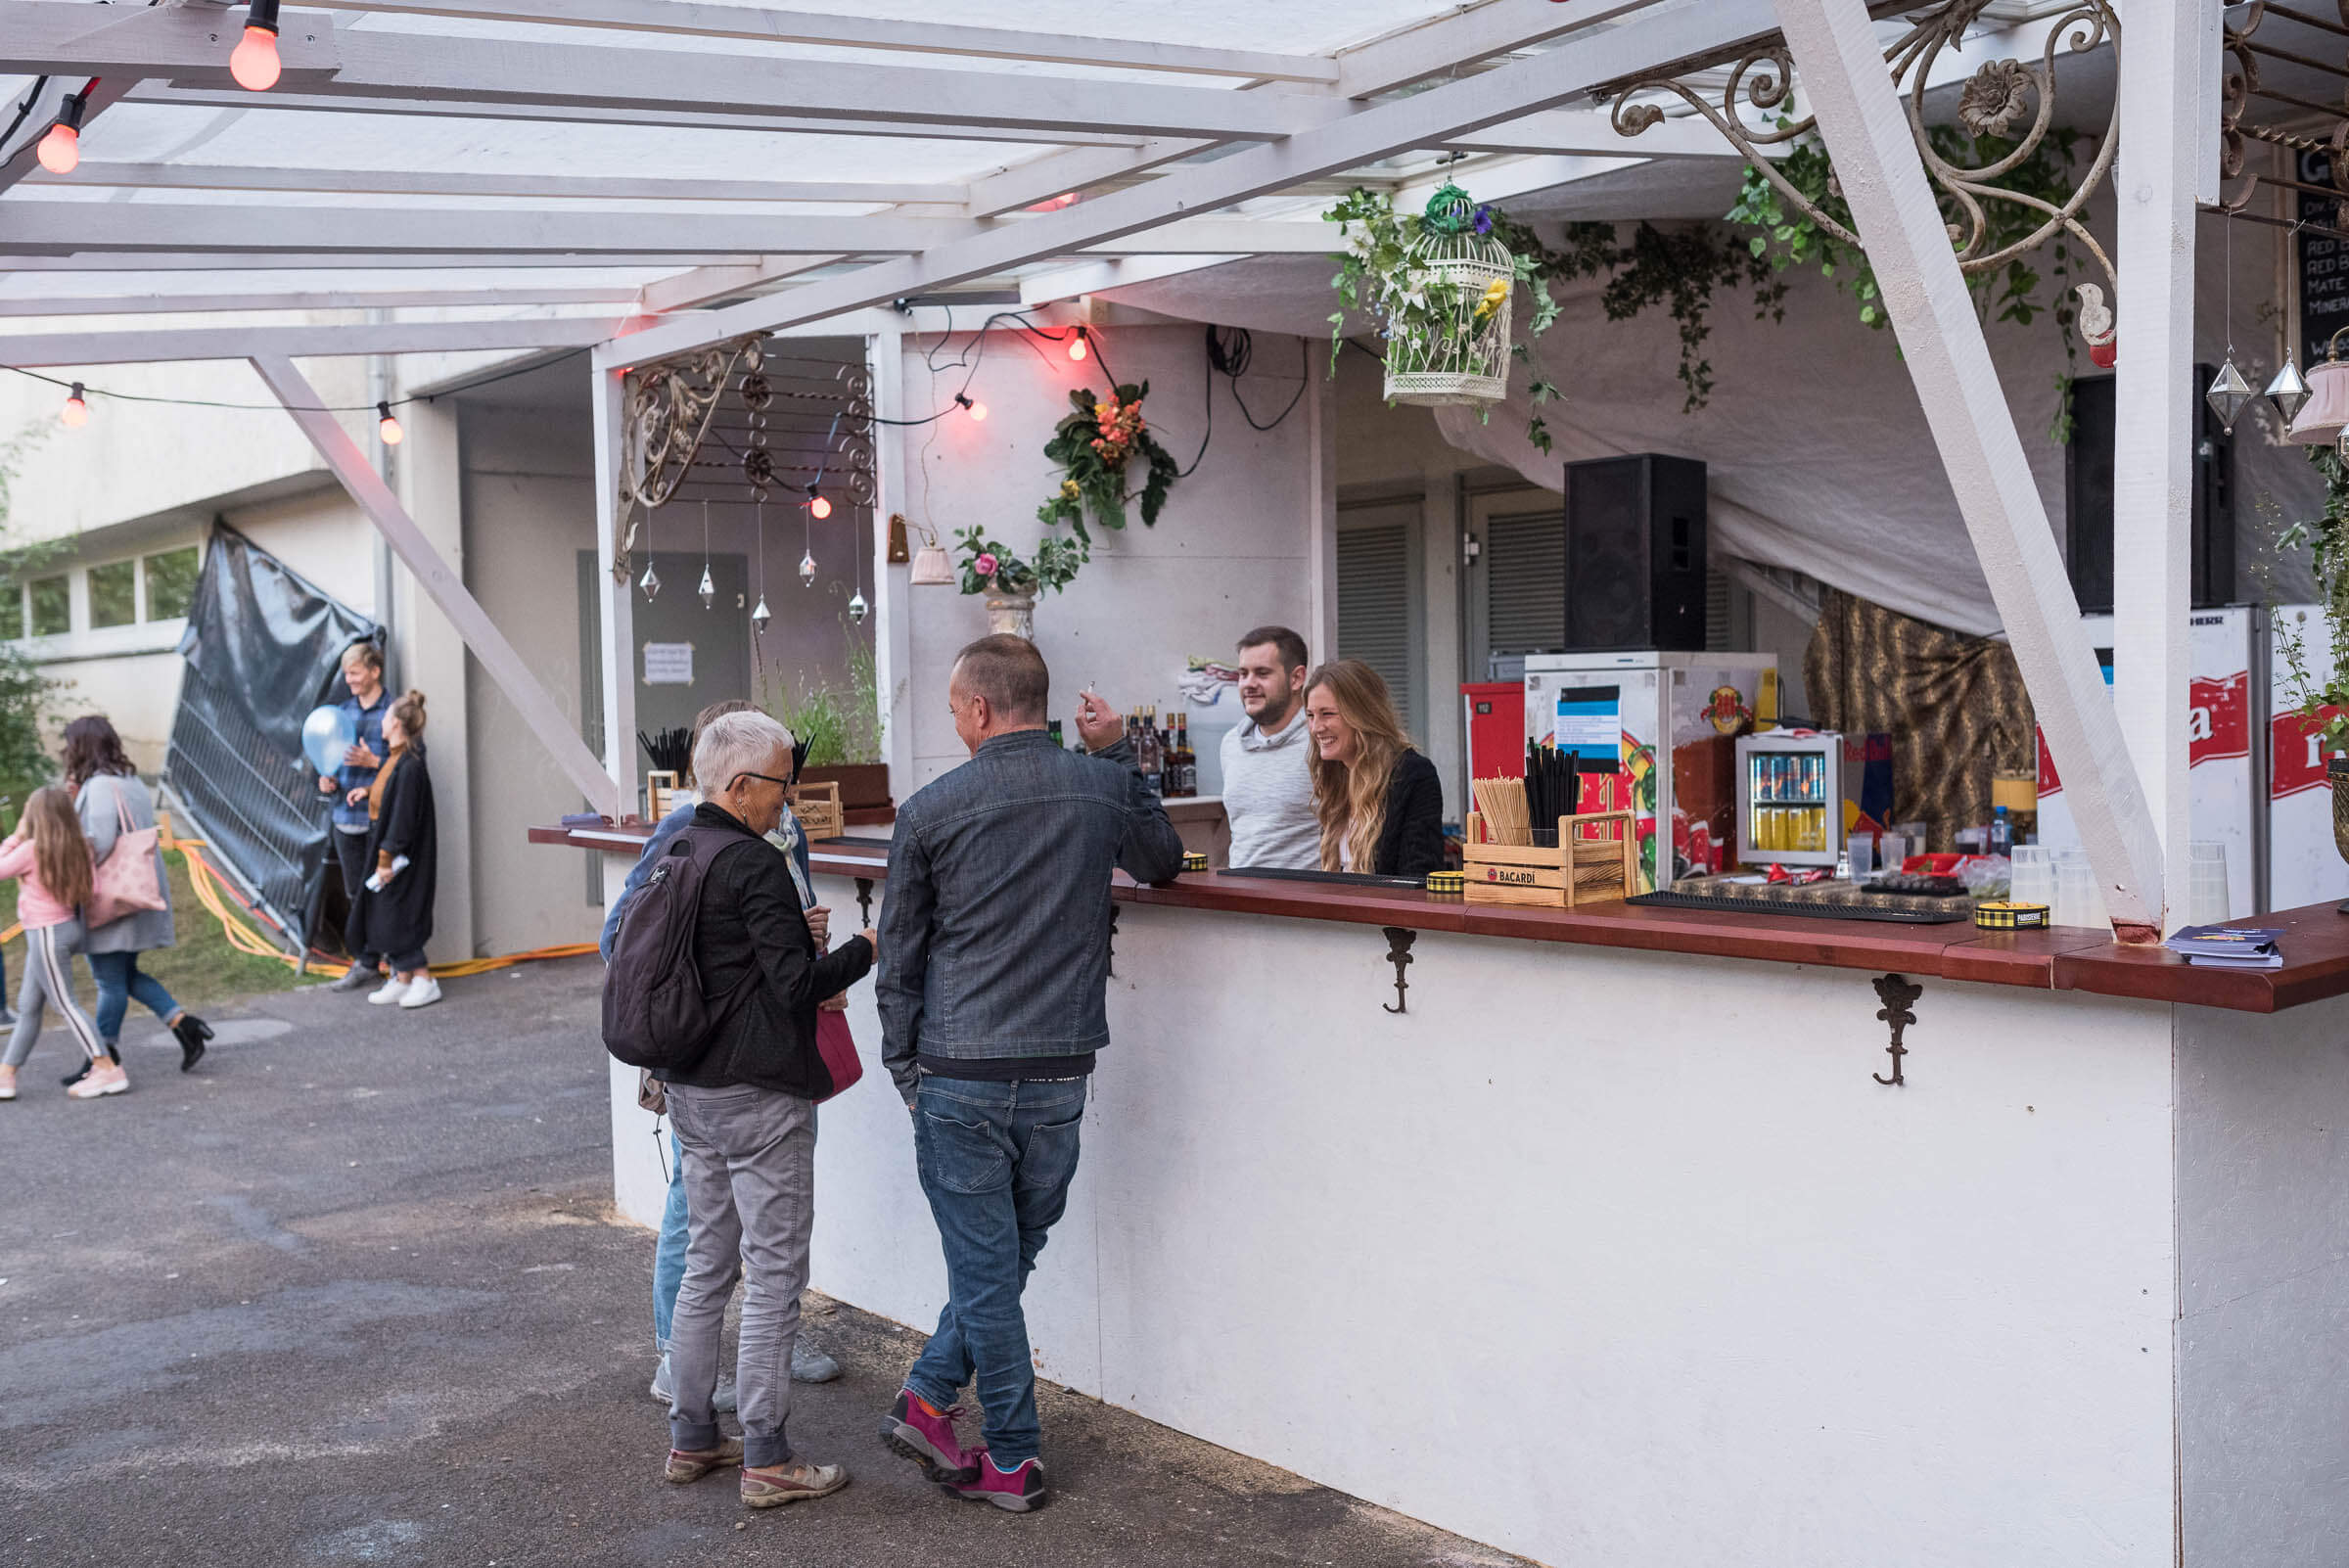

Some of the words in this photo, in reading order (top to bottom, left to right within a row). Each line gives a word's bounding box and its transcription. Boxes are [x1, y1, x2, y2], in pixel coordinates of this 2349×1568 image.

[2308, 240, 2334, 255] RED
[2308, 258, 2334, 275] RED
[2308, 276, 2346, 295] MATE
